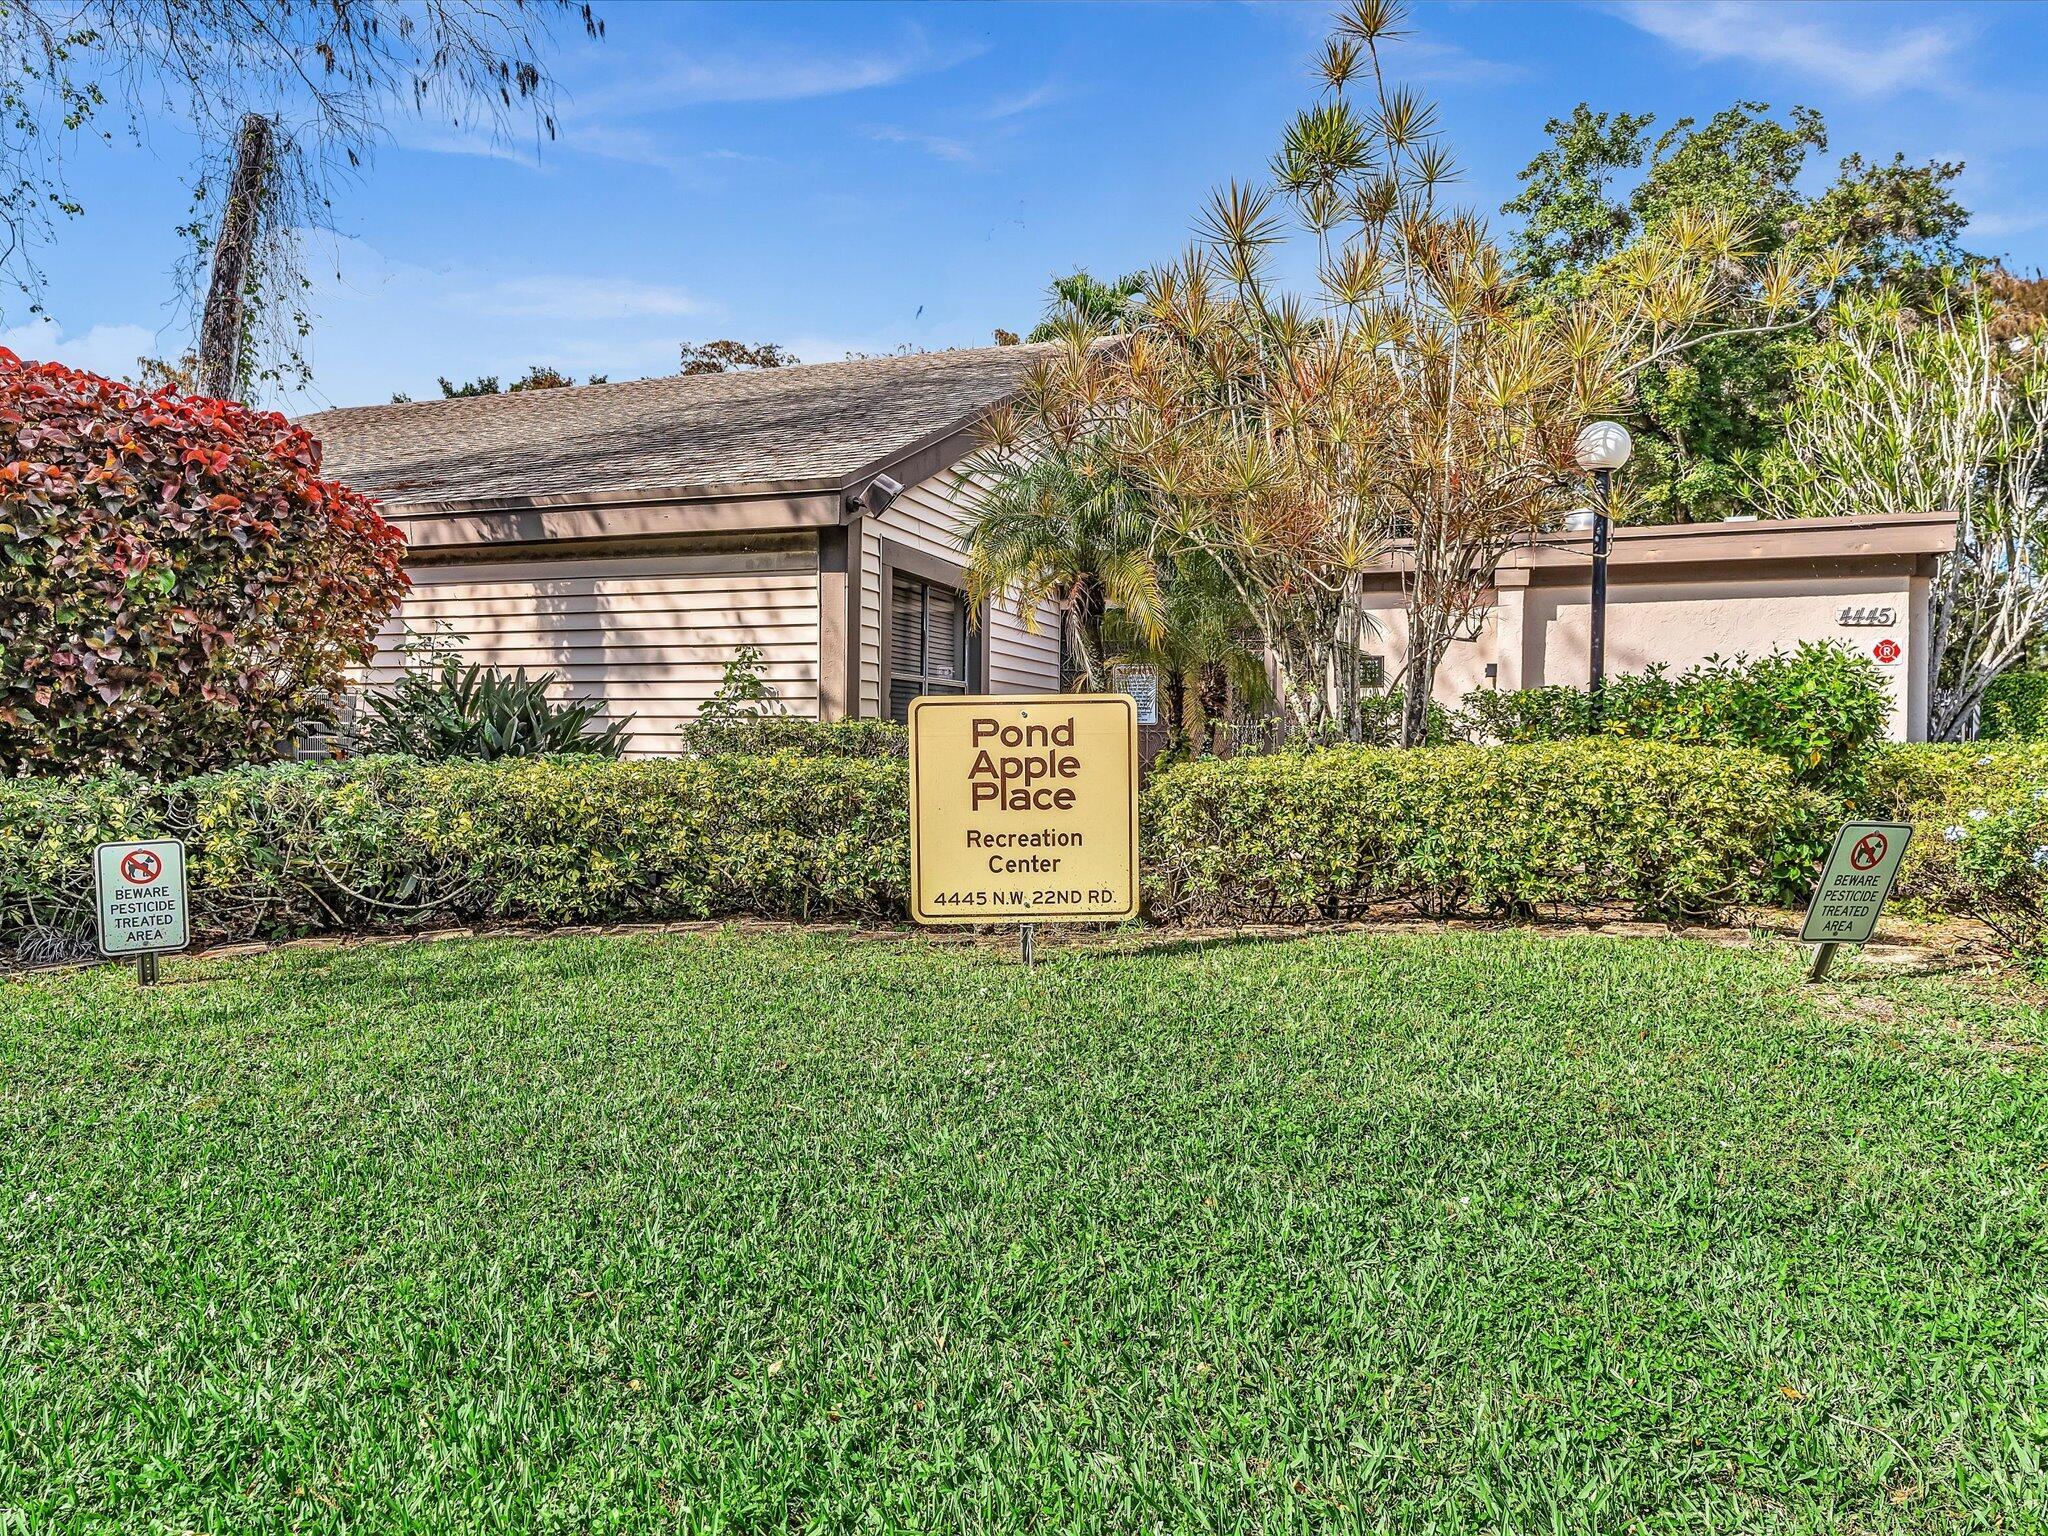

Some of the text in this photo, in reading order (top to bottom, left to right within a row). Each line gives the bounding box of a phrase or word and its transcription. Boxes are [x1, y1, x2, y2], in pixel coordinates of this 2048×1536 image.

[1839, 606, 1892, 625] 4445
[1883, 646, 1891, 656] R
[972, 717, 1075, 748] Pond
[968, 749, 1081, 787] Apple
[972, 781, 1077, 811] Place
[967, 829, 1083, 848] Recreation
[988, 854, 1061, 873] Center
[1834, 874, 1881, 887] BEWARE
[115, 886, 170, 900] BEWARE
[934, 889, 1117, 906] 4445 N.W 22ND RD.
[1823, 890, 1879, 902] PESTICIDE
[110, 900, 176, 915] PESTICIDE
[1821, 905, 1869, 917] TREATED
[114, 914, 173, 928] TREATED
[1822, 920, 1853, 932] AREA
[126, 929, 163, 942] AREA
